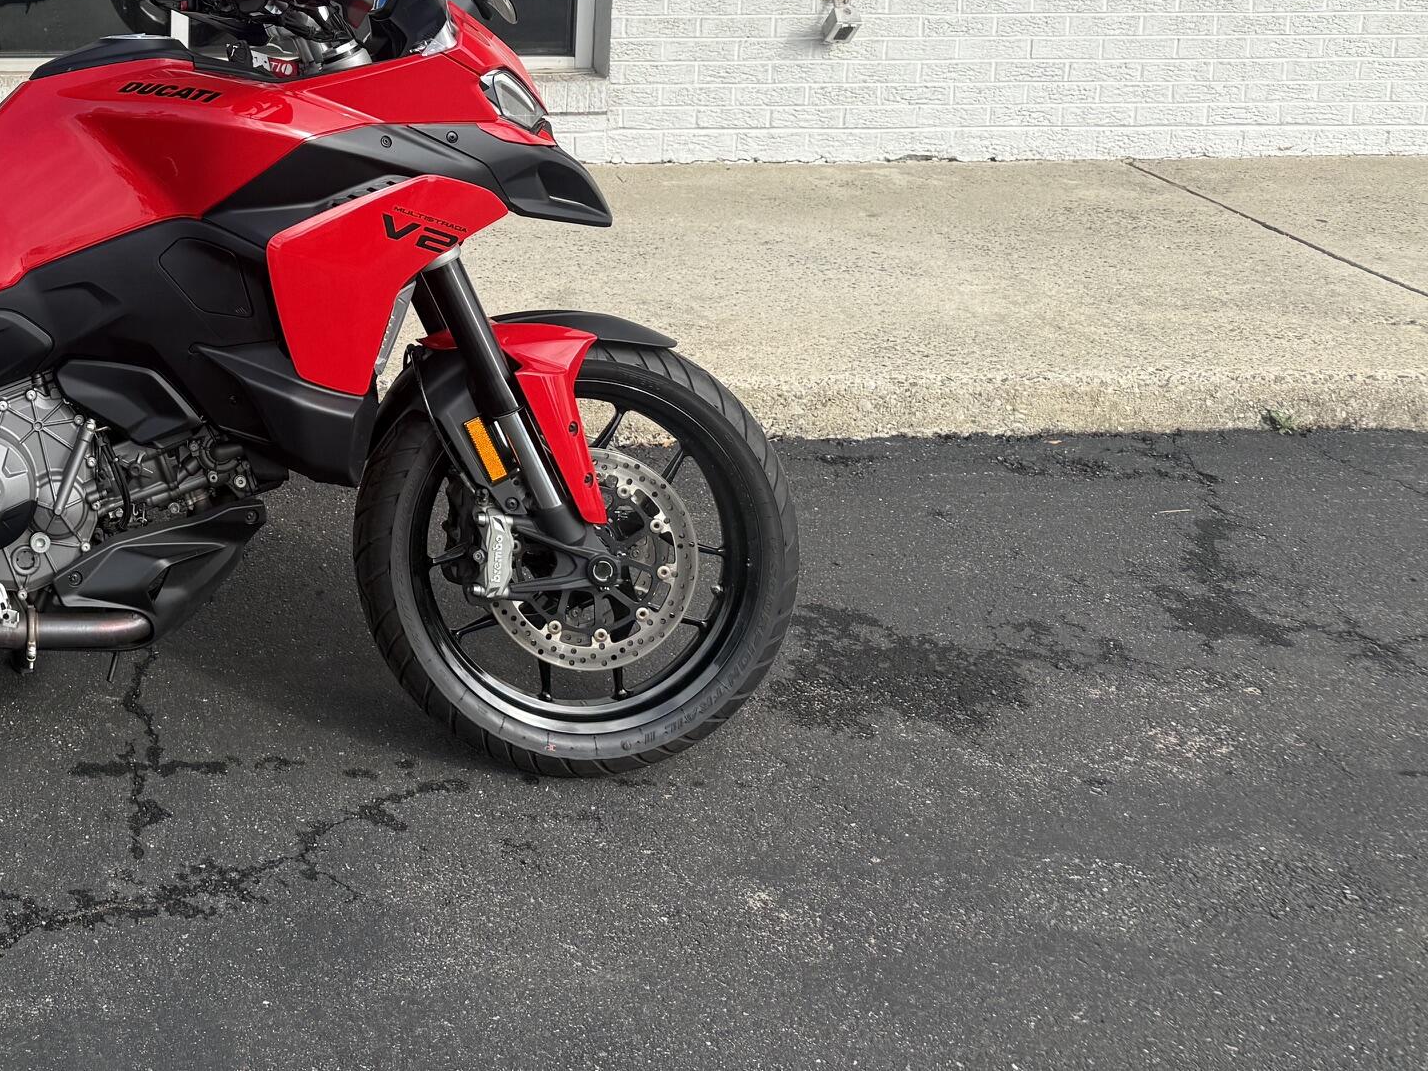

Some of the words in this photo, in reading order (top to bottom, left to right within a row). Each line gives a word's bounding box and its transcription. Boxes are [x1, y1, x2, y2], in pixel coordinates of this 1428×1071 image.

[117, 81, 223, 103] DUCATI
[382, 213, 459, 253] V2
[393, 206, 467, 233] MULTISTRADA
[491, 534, 502, 583] brembo
